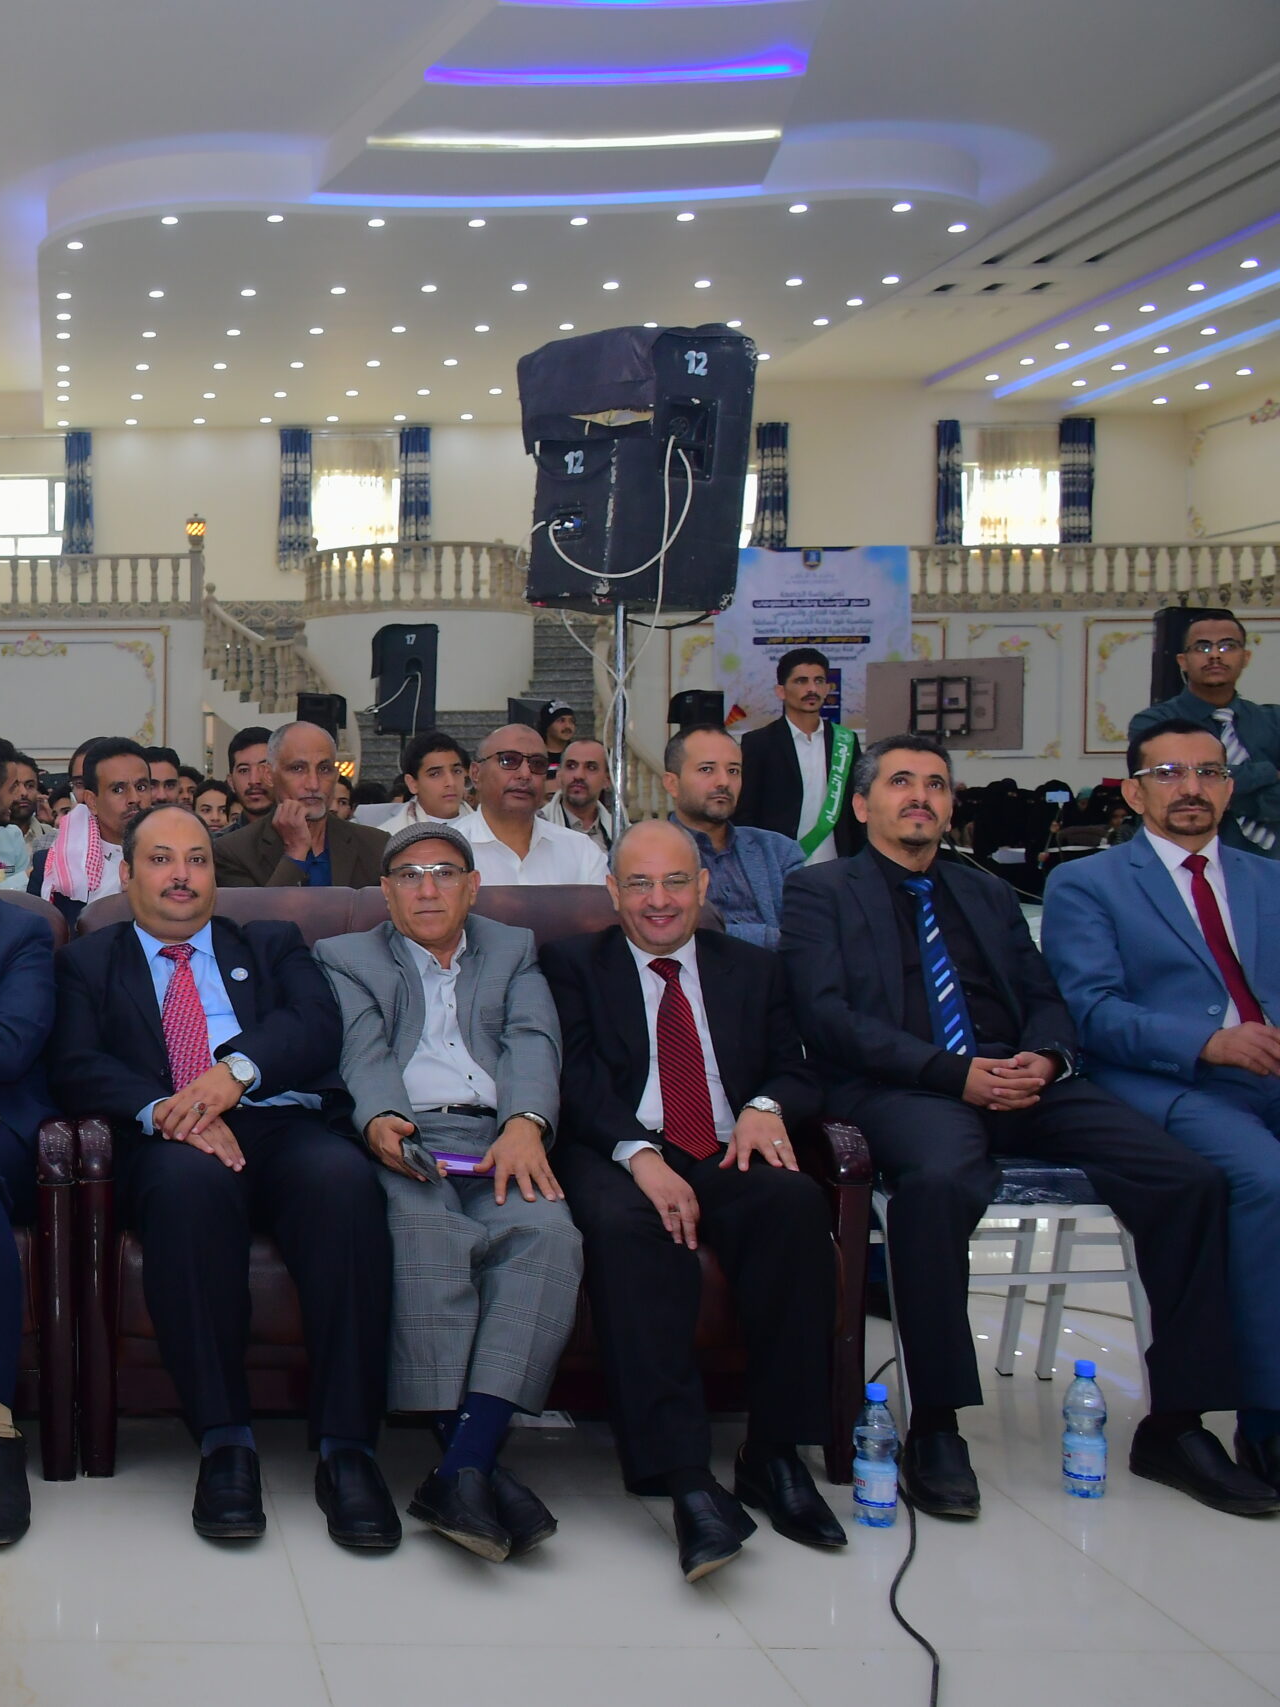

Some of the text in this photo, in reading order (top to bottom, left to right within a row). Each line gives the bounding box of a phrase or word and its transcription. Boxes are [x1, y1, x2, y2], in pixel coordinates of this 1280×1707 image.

[684, 350, 709, 376] 12
[564, 450, 585, 474] 12
[405, 633, 417, 645] 17
